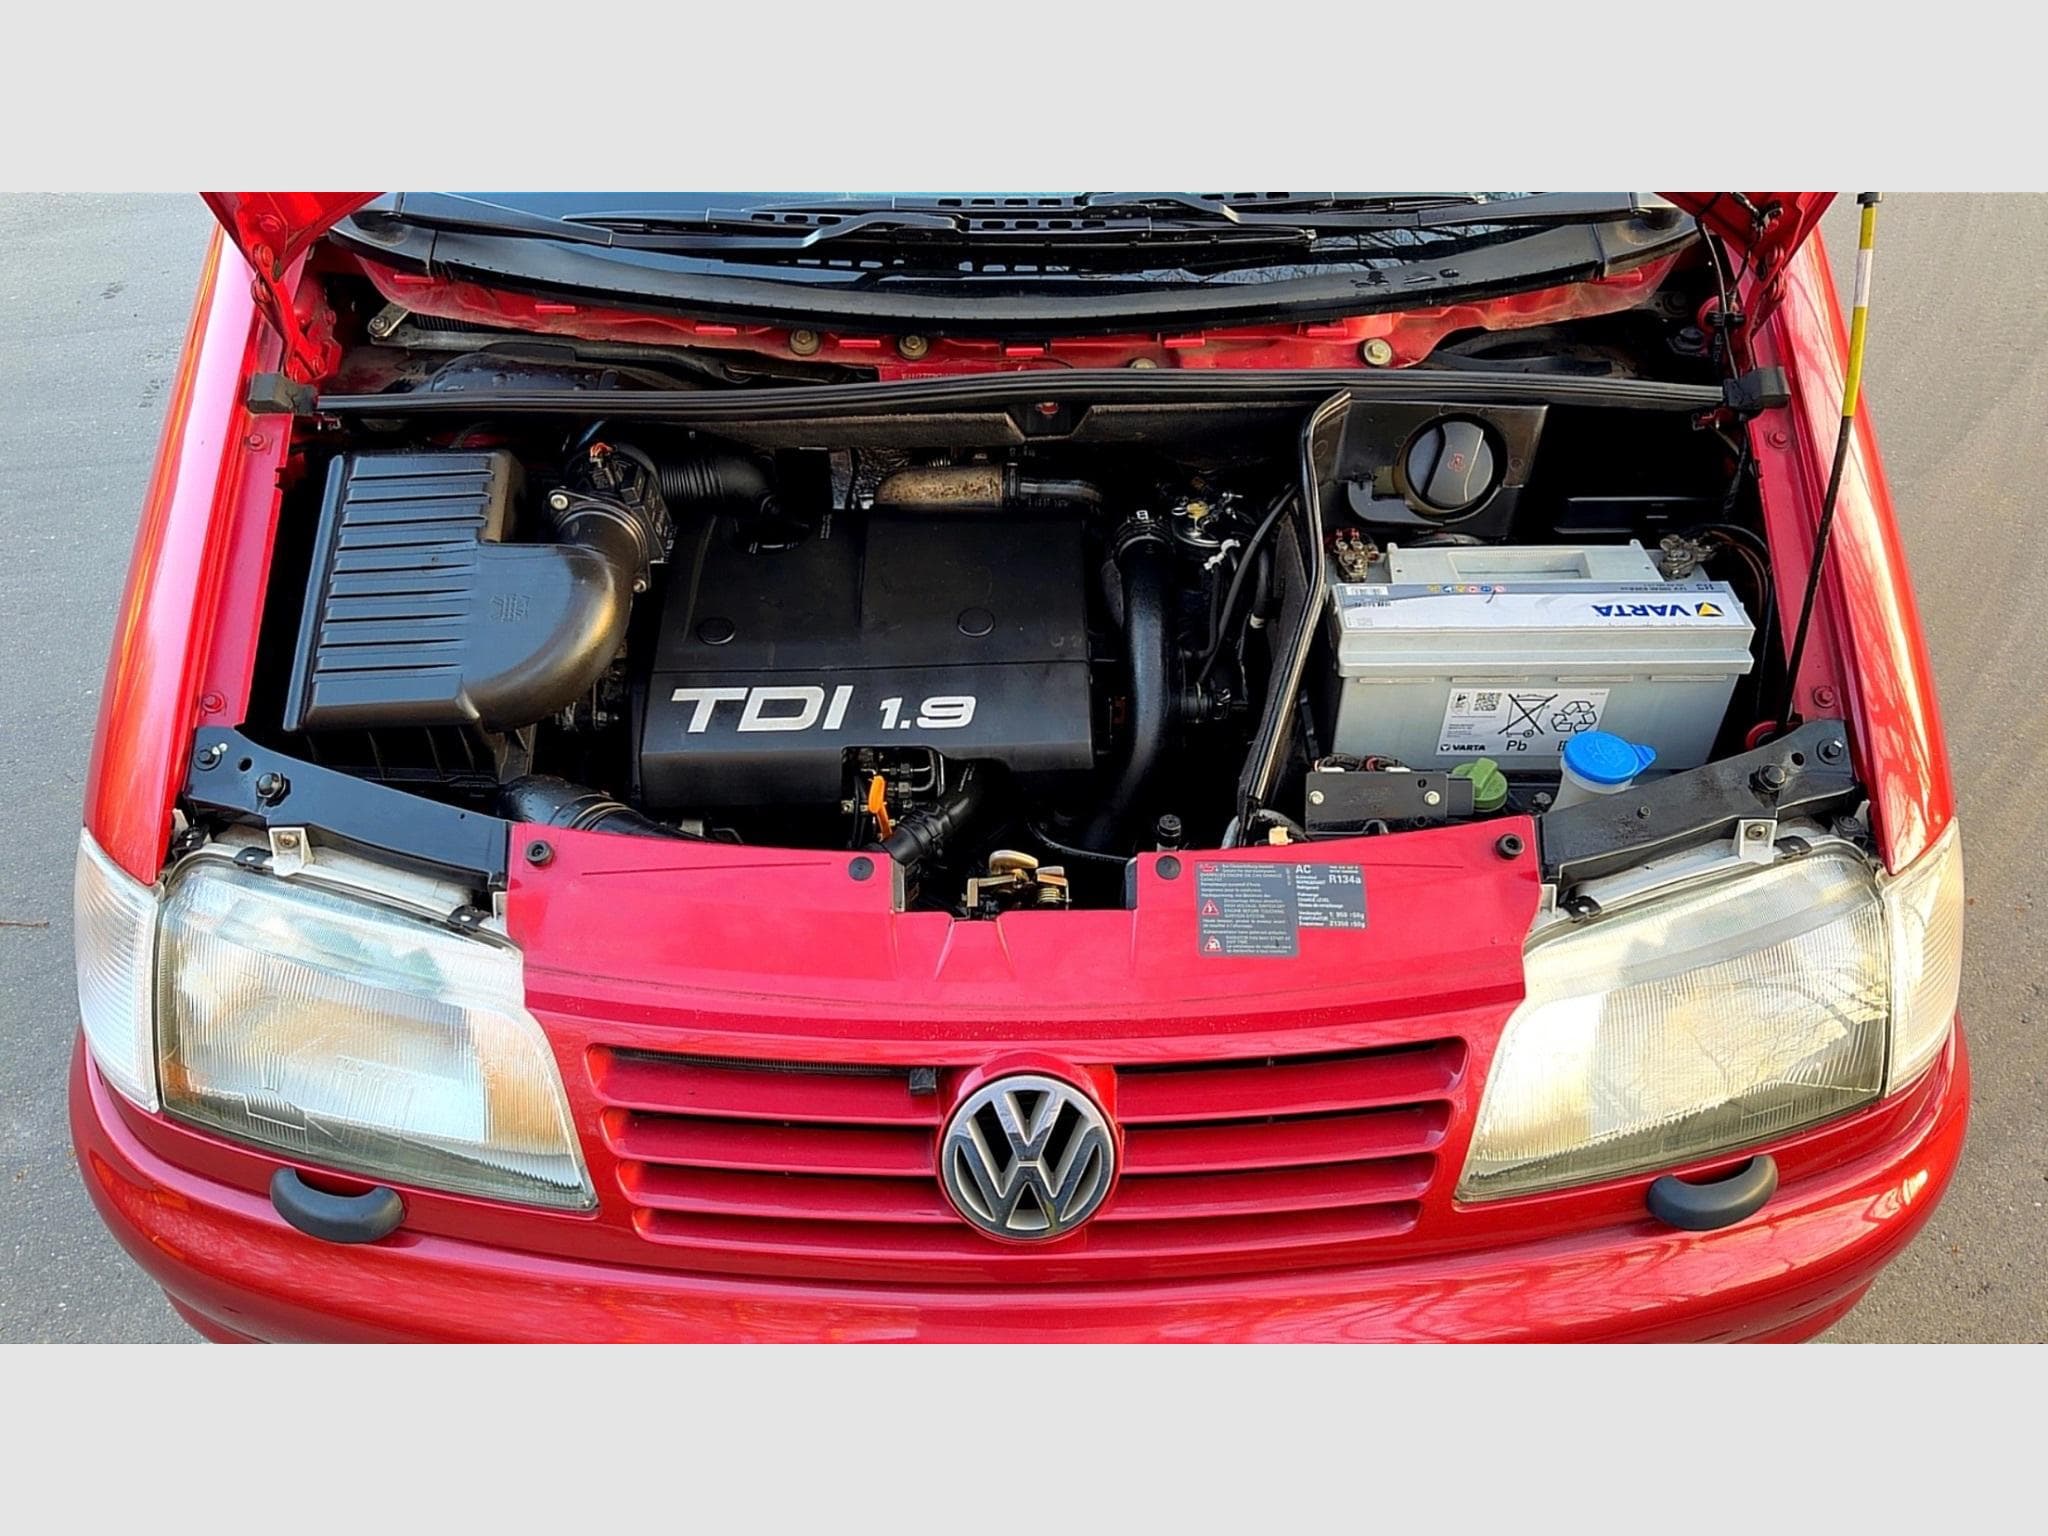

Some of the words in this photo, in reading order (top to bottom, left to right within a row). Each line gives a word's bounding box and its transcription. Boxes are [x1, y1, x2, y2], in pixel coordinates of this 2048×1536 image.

[1591, 604, 1691, 617] VARTA
[671, 685, 854, 733] TDI
[879, 696, 977, 730] 1.9
[1506, 740, 1528, 752] Pb
[1295, 864, 1312, 874] AC
[1328, 874, 1362, 885] R134a
[942, 1075, 1114, 1239] VW
